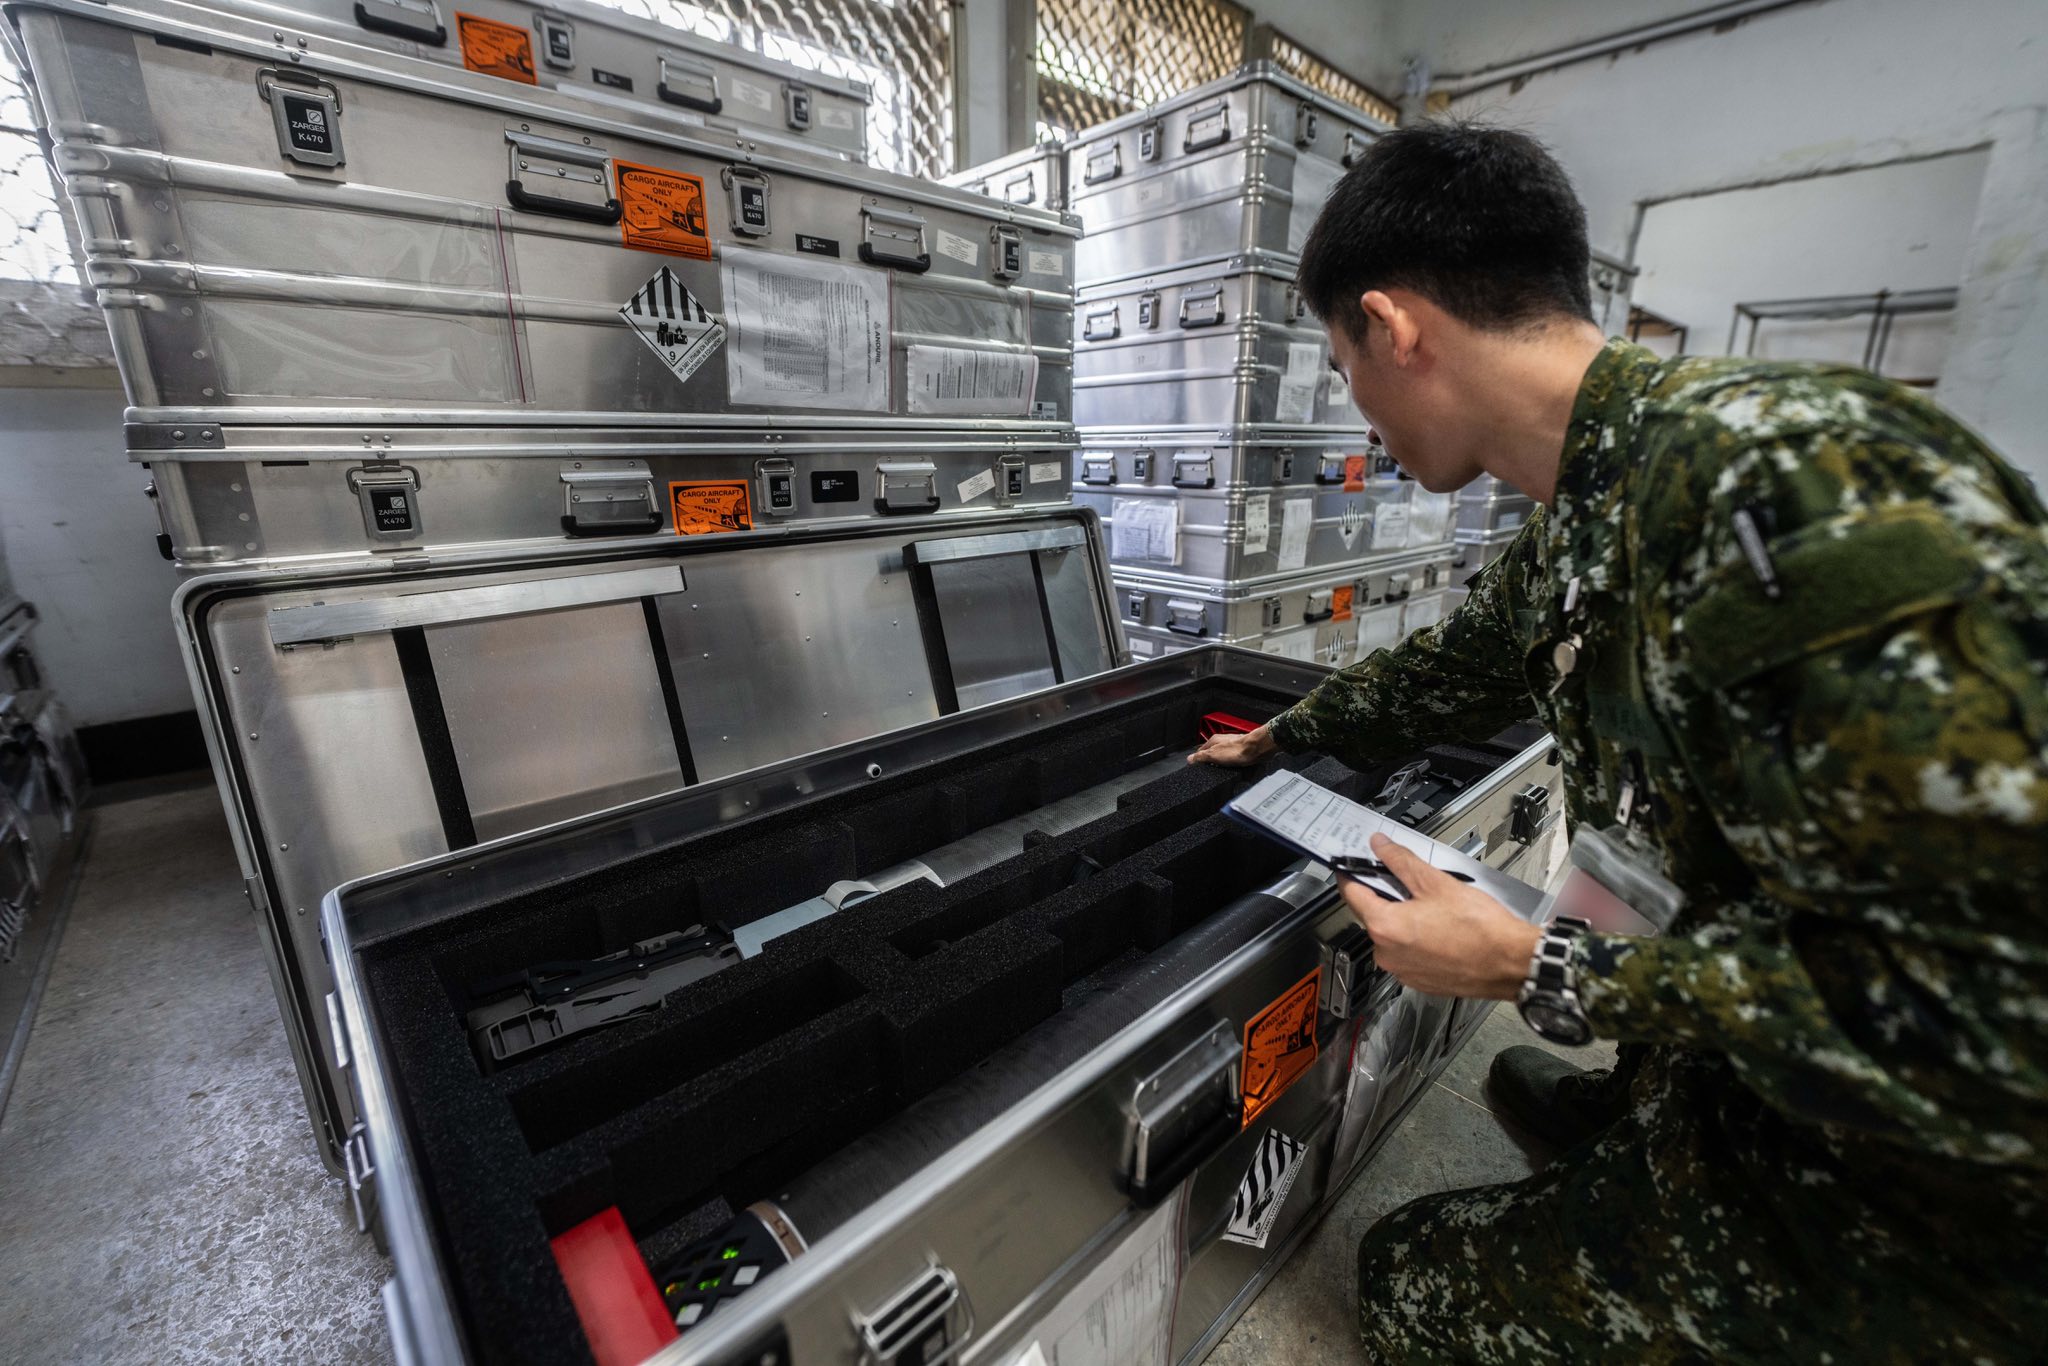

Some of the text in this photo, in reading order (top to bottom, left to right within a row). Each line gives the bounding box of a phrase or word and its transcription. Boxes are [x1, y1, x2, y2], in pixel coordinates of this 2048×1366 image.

[292, 120, 325, 133] ZARGES
[298, 132, 324, 143] K470
[627, 173, 694, 193] CARGO AIRCRAFT
[652, 187, 672, 197] ONLY
[747, 211, 762, 220] K470
[688, 349, 702, 363] LITHIUM
[704, 328, 722, 347] BATTERIES
[669, 351, 676, 361] 9
[685, 357, 704, 376] CONTAINED
[704, 337, 723, 356] EQUIPMENT
[682, 489, 740, 498] CARGO AIRCRAFT
[378, 508, 407, 516] ZARGES
[383, 517, 406, 525] K470
[1255, 1011, 1280, 1037] CARGO
